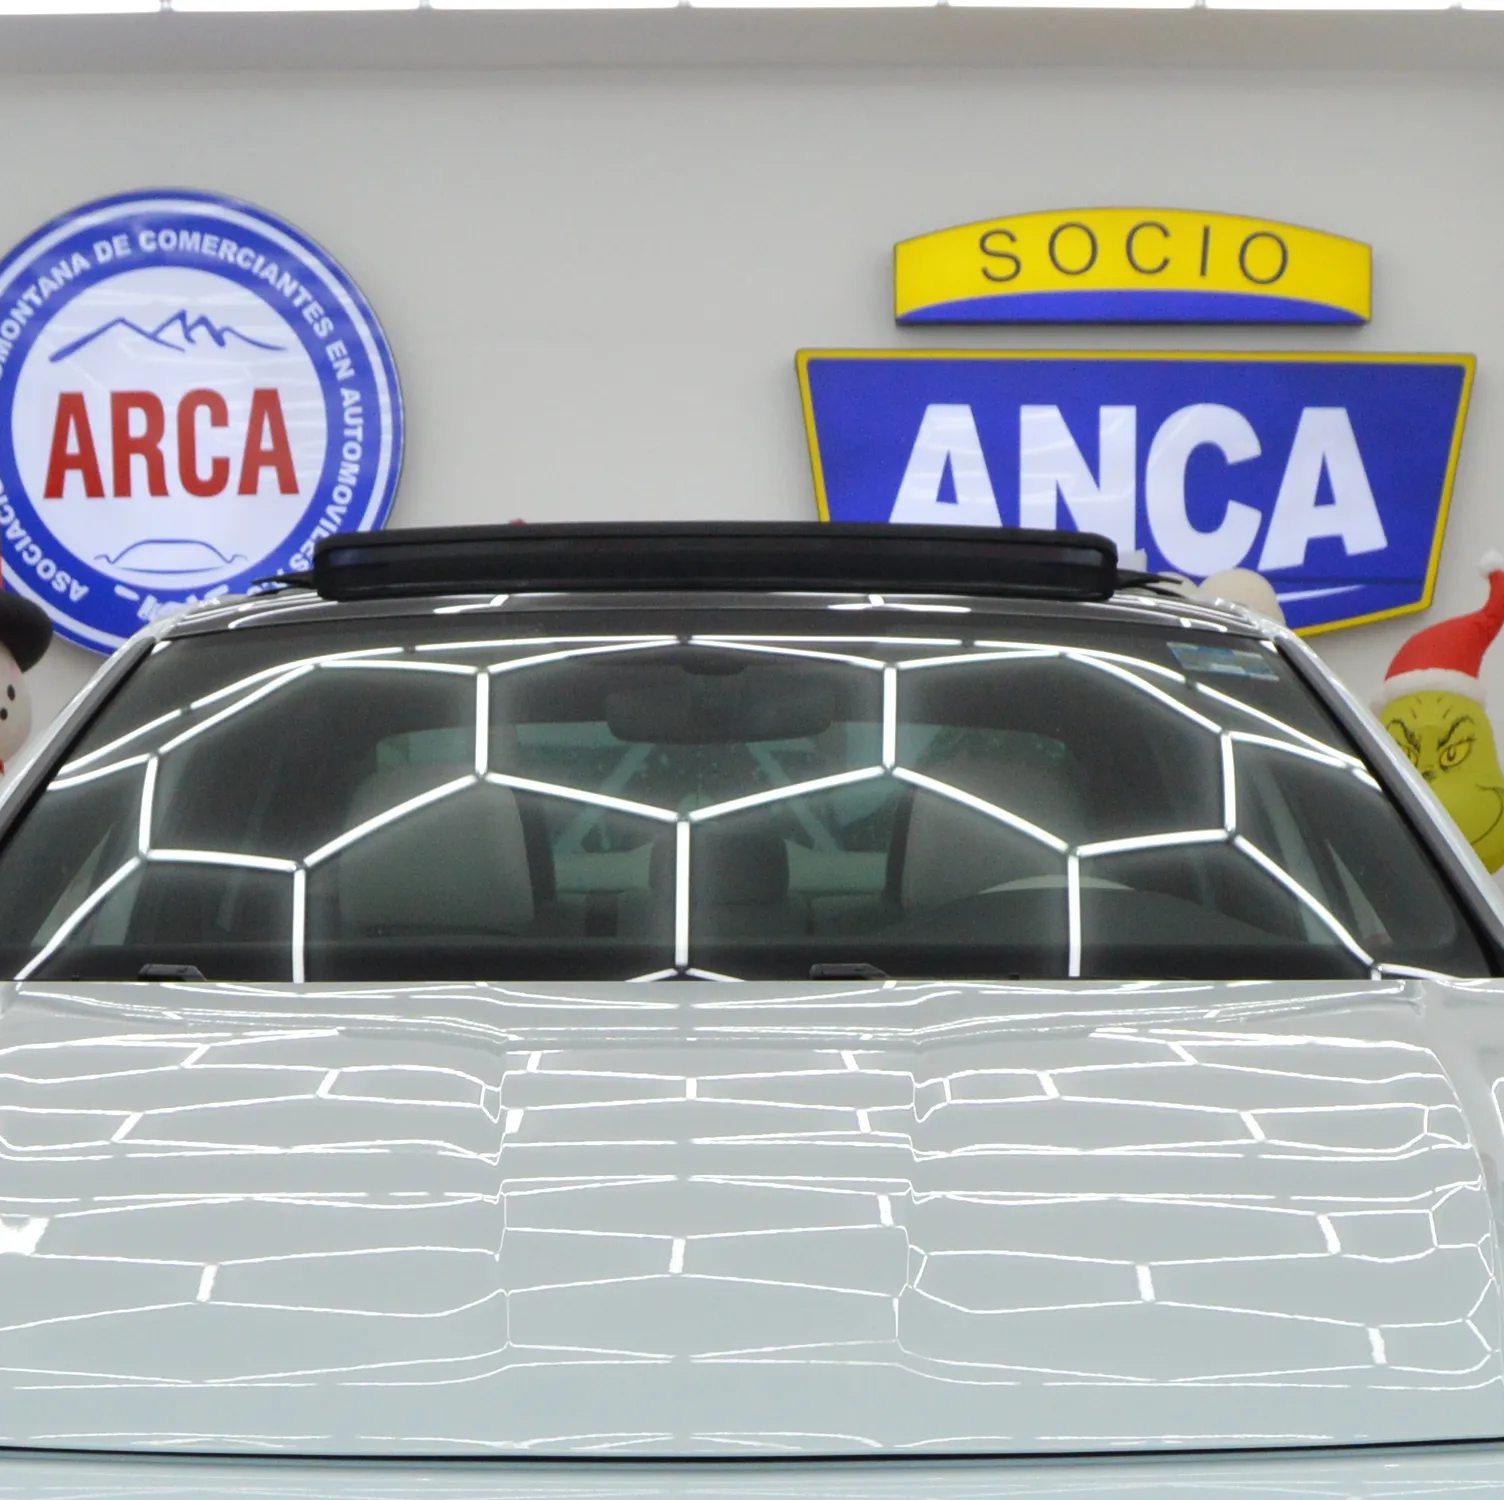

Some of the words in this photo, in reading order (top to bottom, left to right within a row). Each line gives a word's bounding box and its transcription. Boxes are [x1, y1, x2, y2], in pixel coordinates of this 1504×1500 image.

[94, 234, 132, 264] DE
[138, 229, 335, 341] COMERCIANTES
[978, 220, 1289, 284] SOCIO
[324, 341, 355, 381] EN
[43, 387, 300, 499] ARCA
[288, 386, 364, 571] AUTOMOVILES
[887, 402, 1389, 577] ANCA
